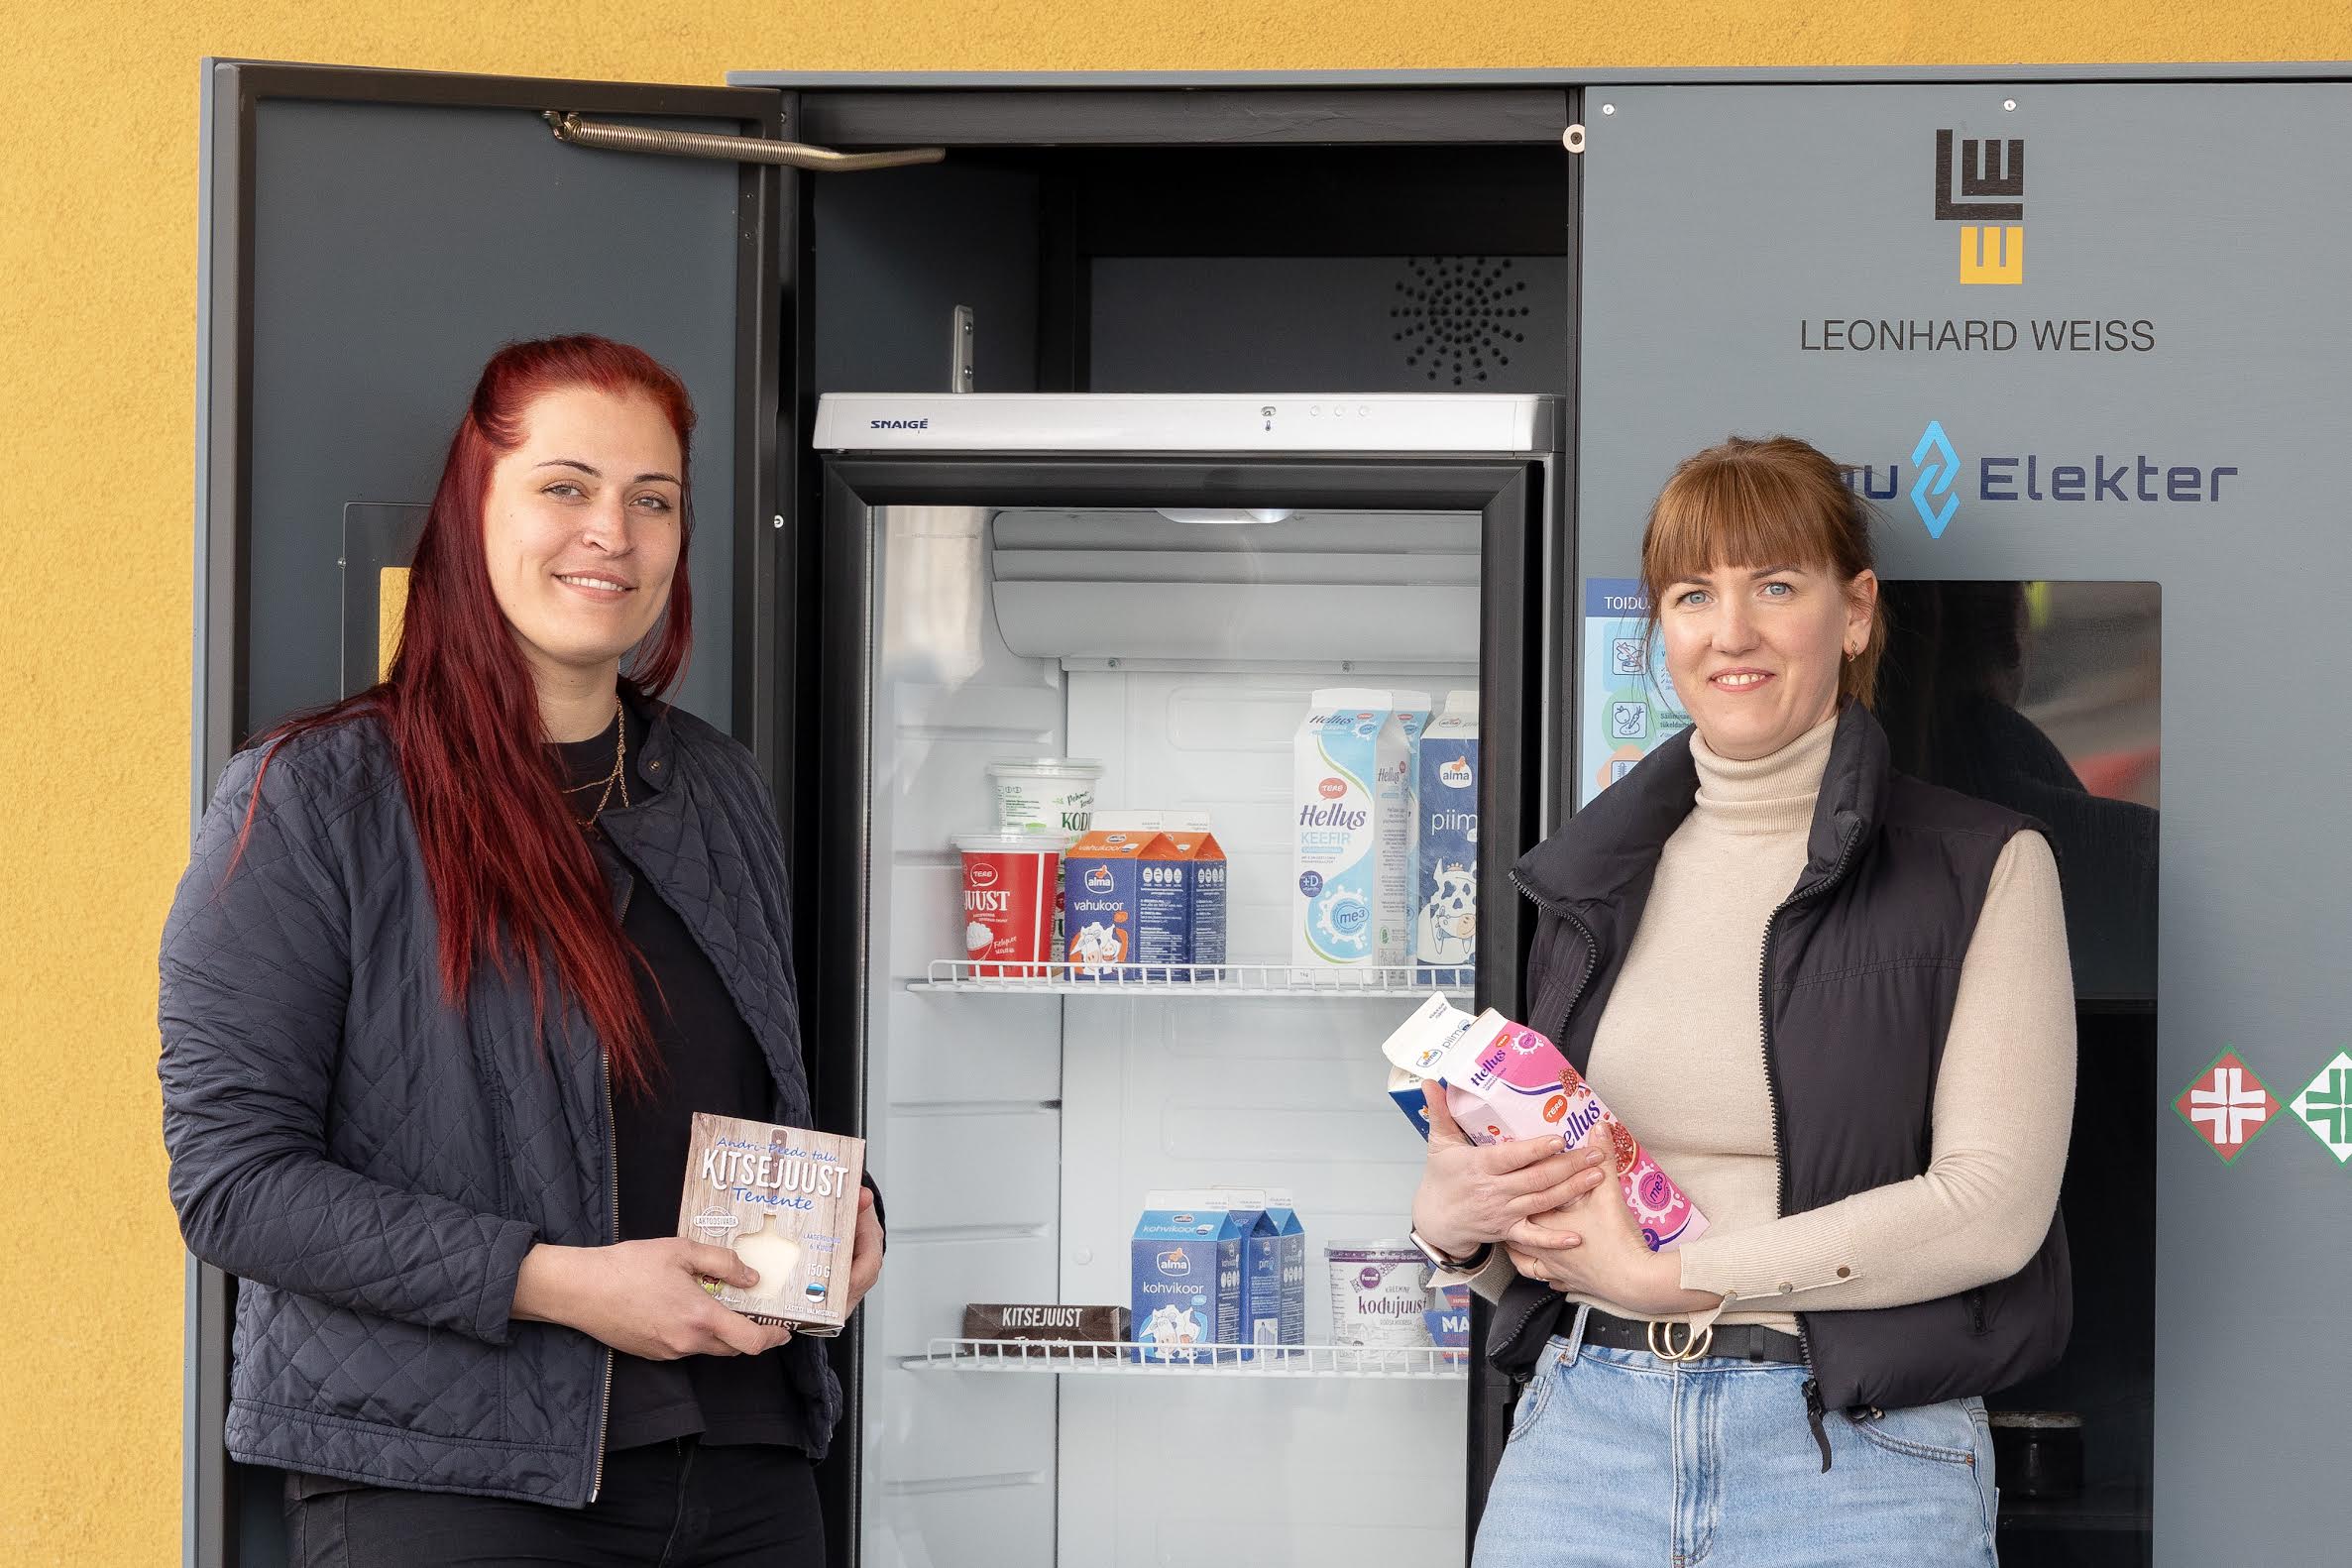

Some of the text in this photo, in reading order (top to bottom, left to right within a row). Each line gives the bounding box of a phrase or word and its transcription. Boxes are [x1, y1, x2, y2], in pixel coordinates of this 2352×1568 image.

[1800, 319, 2156, 352] LEONHARD WEISS
[1979, 455, 2239, 503] Elekter
[1604, 596, 1651, 610] TOIDU
[1378, 768, 1400, 784] Hellus
[1442, 770, 1470, 781] alma
[1299, 803, 1367, 831] Hellus
[1300, 832, 1351, 844] KEEFIR
[1087, 876, 1111, 887] alma
[1073, 899, 1125, 912] vahukoor
[1339, 909, 1366, 924] me3
[1442, 1029, 1463, 1049] piim
[1422, 1051, 1439, 1066] alma
[1470, 1050, 1507, 1086] Hellus
[1546, 1098, 1565, 1119] TERE
[1560, 1099, 1602, 1152] ellus
[811, 1150, 840, 1163] talu
[702, 1148, 849, 1199] KITSEJUUST
[1649, 1174, 1664, 1202] me3
[731, 1186, 815, 1211] Tenente
[1142, 1224, 1196, 1233] kohvikoor
[807, 1263, 831, 1279] 150 G
[1160, 1258, 1187, 1270] alma
[1143, 1281, 1205, 1294] kohvikoor
[1358, 1295, 1427, 1319] kodujuust
[1002, 1306, 1083, 1327] KITSEJUUST
